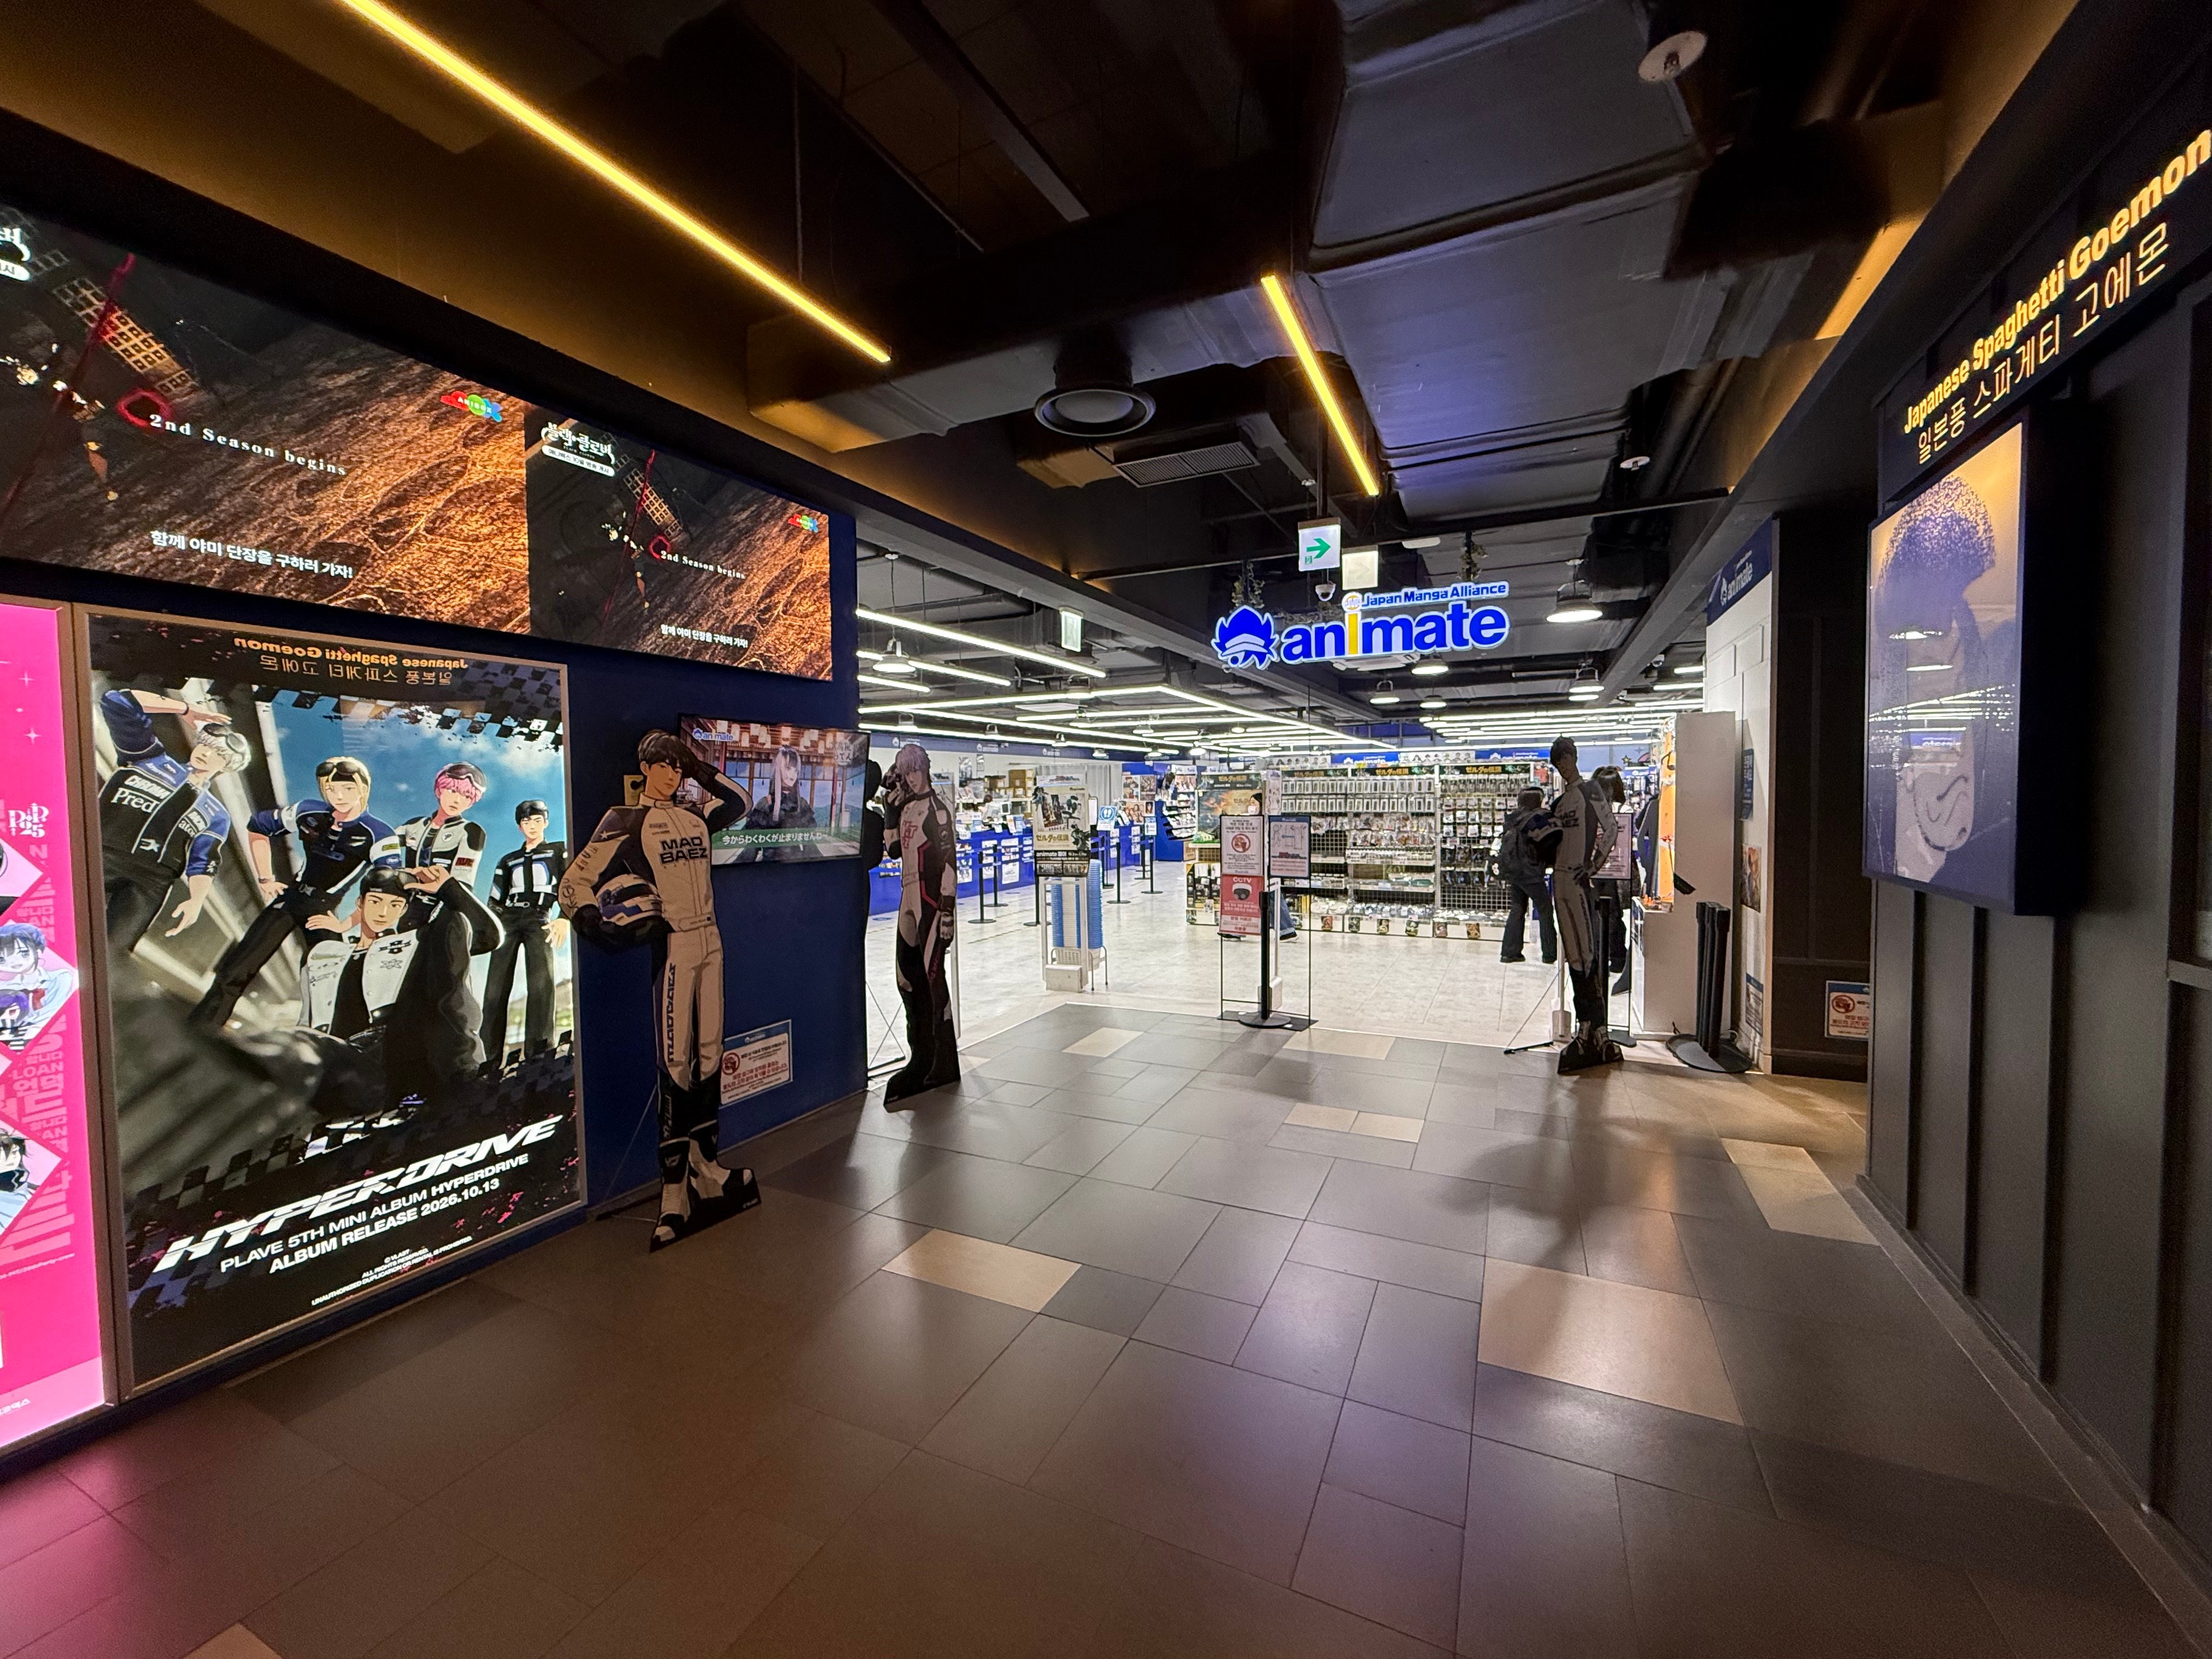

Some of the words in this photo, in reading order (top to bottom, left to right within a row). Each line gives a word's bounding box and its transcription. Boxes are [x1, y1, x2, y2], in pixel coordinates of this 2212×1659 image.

[1904, 359, 1970, 433] Japanese
[1972, 259, 2065, 370] Spaghetti
[2069, 128, 2211, 281] Goemon
[1918, 397, 1966, 465] 일본풍
[1973, 314, 2060, 419] 스파게티
[2072, 222, 2169, 337] 고에몬
[149, 414, 191, 436] 2nd
[202, 427, 274, 458] Season
[284, 450, 346, 476] begins
[150, 529, 185, 550] 함께
[189, 538, 222, 556] 야미
[226, 545, 273, 566] 단장을
[275, 554, 319, 574] 구하러
[321, 562, 353, 579] 가자!
[661, 550, 679, 563] 2nd
[682, 556, 714, 572] Season
[717, 565, 746, 579] begins
[1362, 594, 1402, 607] Japan
[1404, 590, 1448, 602] Manga
[1449, 583, 1506, 597] Alliance
[1282, 601, 1508, 662] animate
[111, 787, 160, 813] Pred
[1560, 810, 1576, 820] AD
[660, 848, 708, 864] BAEZ
[661, 837, 702, 851] MAD
[1036, 834, 1069, 843] ゼルダの伝説
[12, 1061, 64, 1080] LOAN
[153, 1115, 563, 1273] HYPERDRIVE
[221, 1243, 282, 1273] PLAVE
[288, 1227, 325, 1248] 5TH
[328, 1211, 366, 1238] MINI
[371, 1189, 427, 1218] ALBUM
[431, 1154, 528, 1197] HYPERDRIVE
[269, 1239, 337, 1273] ALBUM
[342, 1210, 418, 1248] RELEASE
